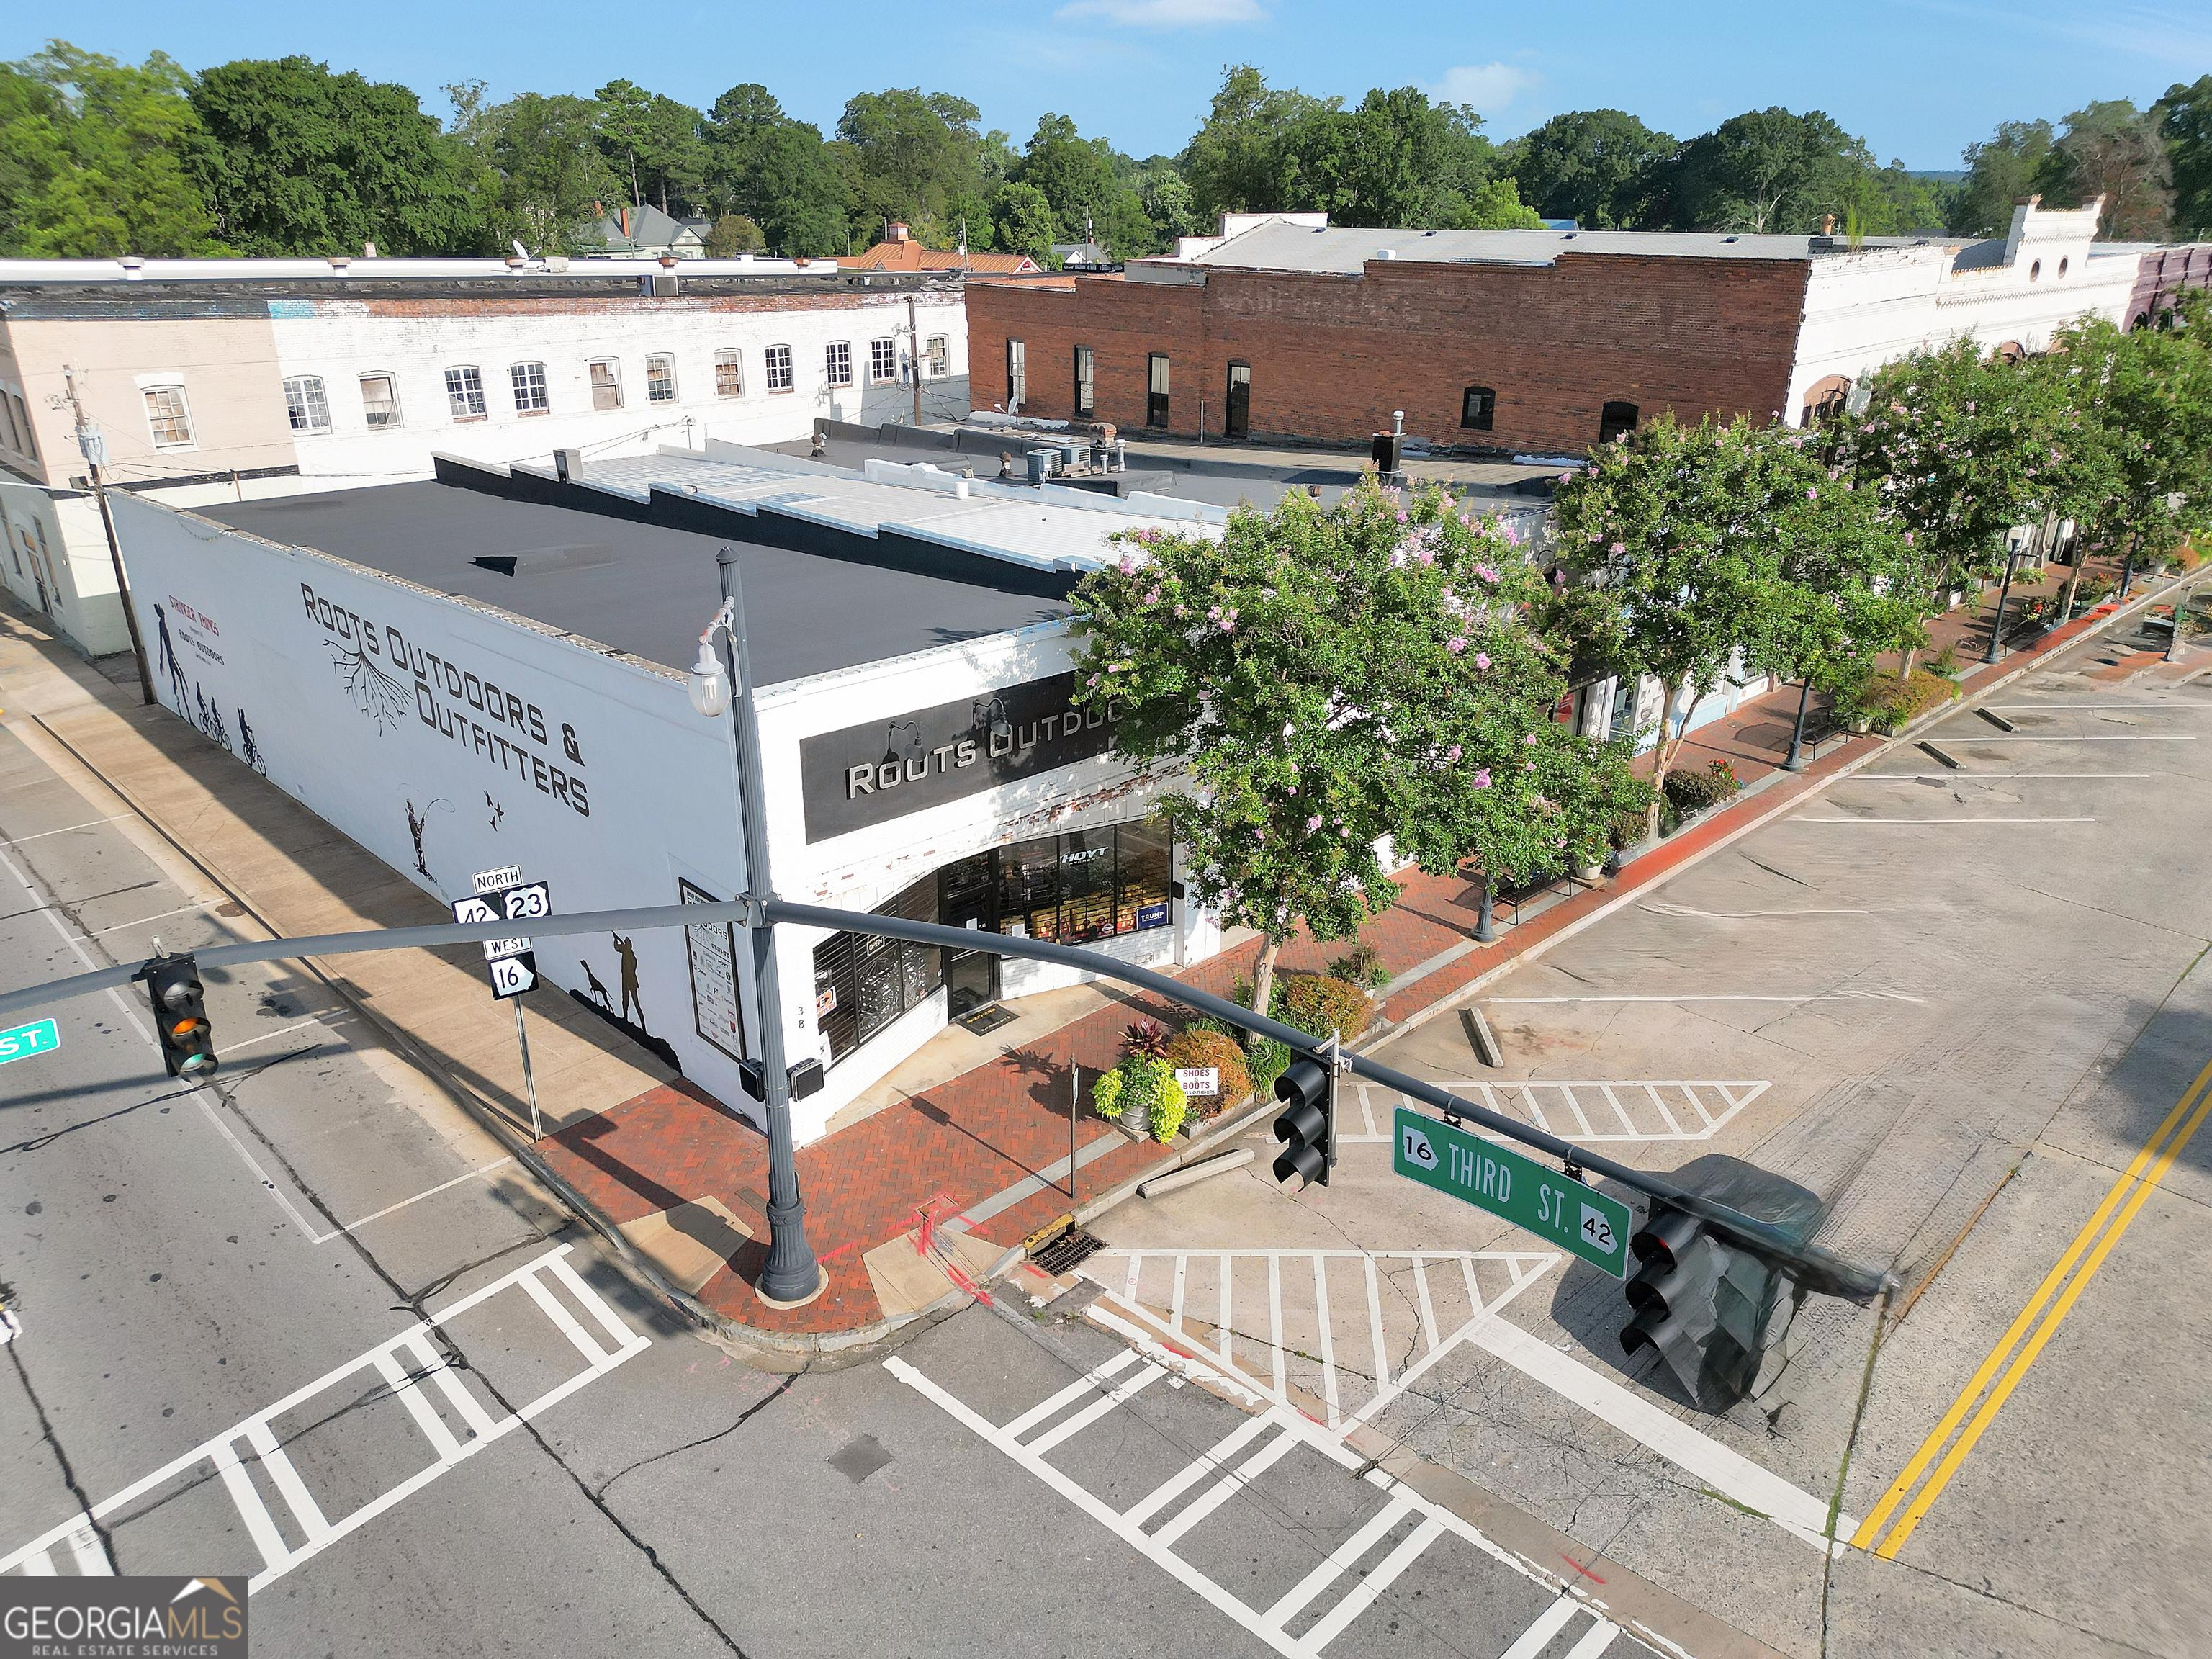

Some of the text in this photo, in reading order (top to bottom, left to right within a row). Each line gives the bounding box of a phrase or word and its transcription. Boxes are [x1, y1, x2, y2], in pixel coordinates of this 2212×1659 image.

[300, 582, 586, 768] ROOTS OUTDOORS &
[414, 679, 590, 817] OUTFITTERS
[846, 698, 1123, 800] ROOTS OUTDOO
[1061, 846, 1109, 863] HOYT
[477, 870, 519, 889] NORTH
[510, 893, 542, 918] 23
[1141, 911, 1164, 921] TRUMP
[490, 937, 524, 953] WEST
[869, 938, 884, 951] OPEN
[498, 966, 518, 989] 16
[1183, 1069, 1210, 1077] SHOES
[1406, 1136, 1611, 1246] 16 THIRD ST. 42
